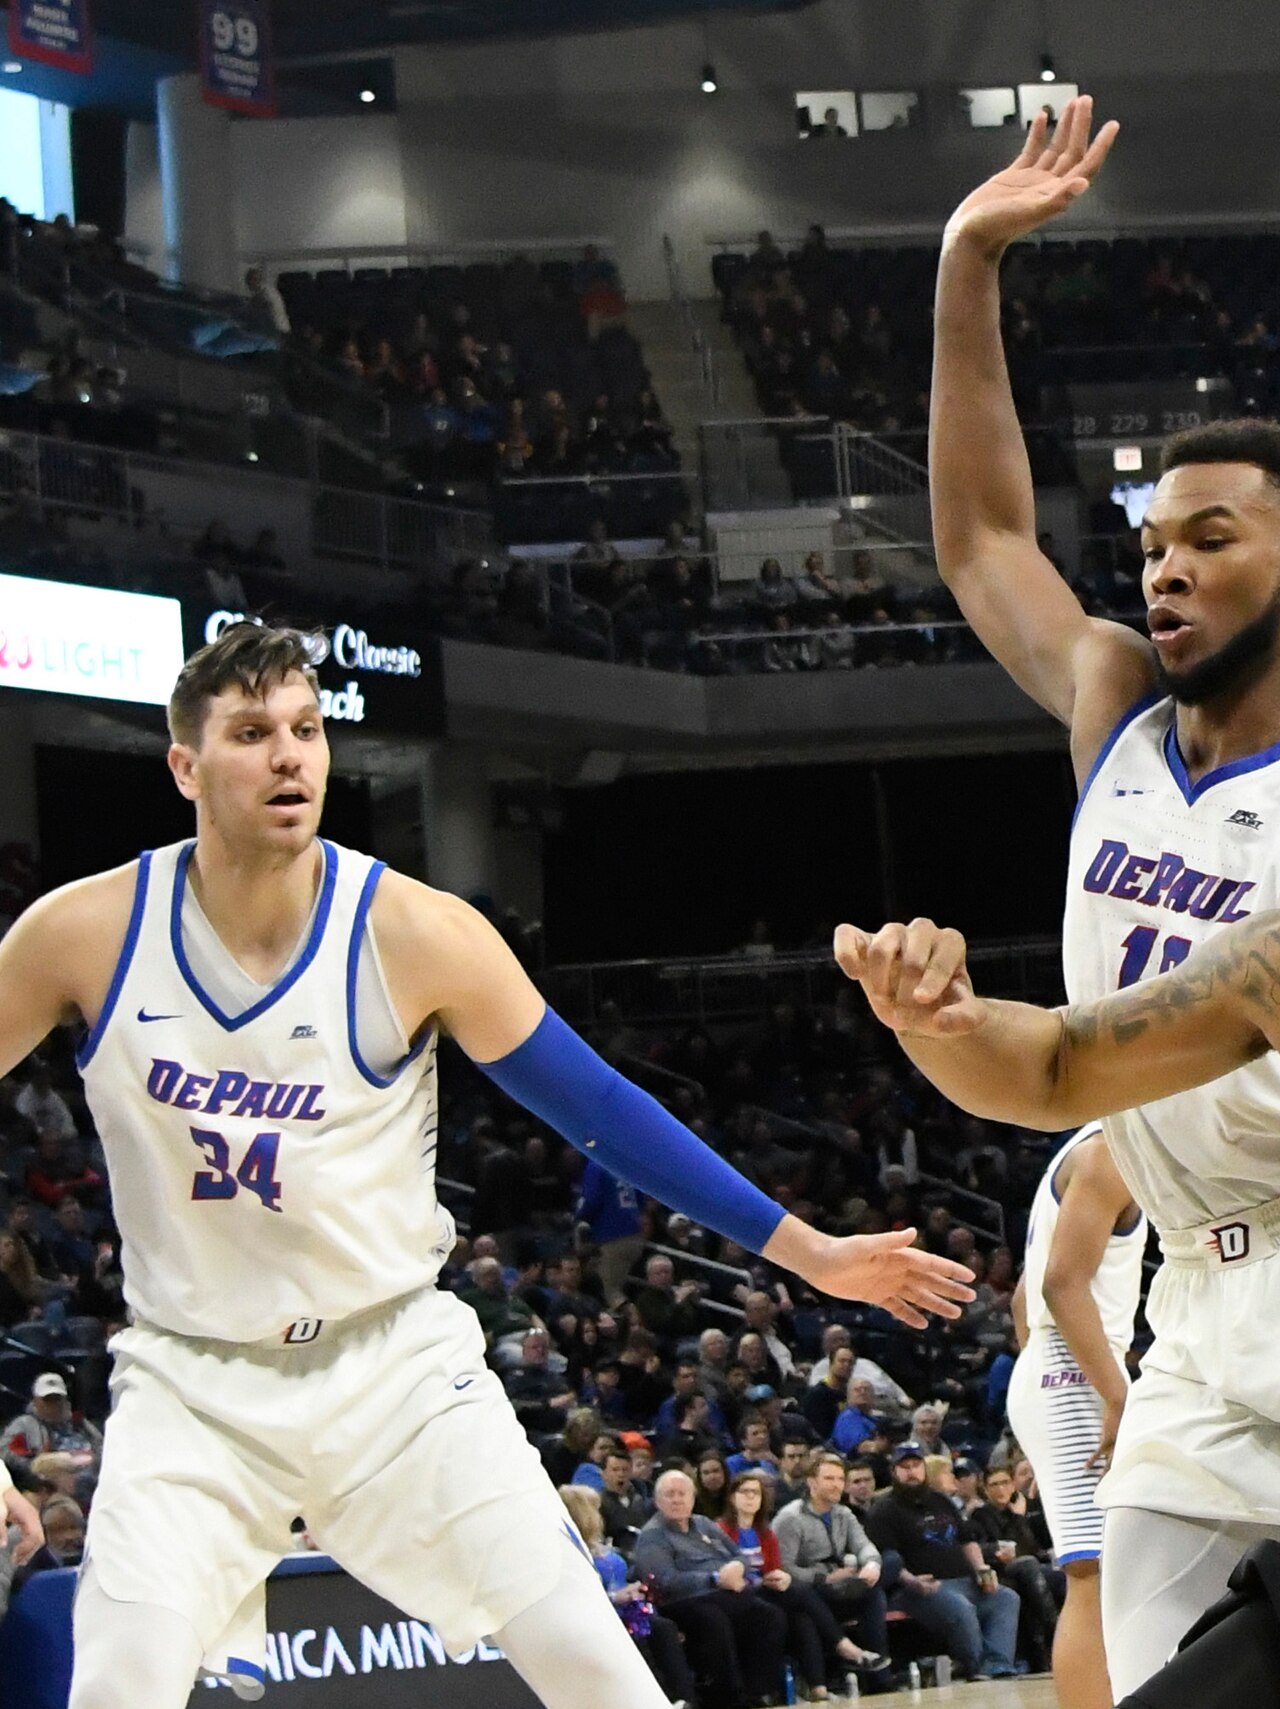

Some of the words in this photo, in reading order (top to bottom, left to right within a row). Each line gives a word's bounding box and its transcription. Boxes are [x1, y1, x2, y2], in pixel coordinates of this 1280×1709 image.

[212, 12, 259, 57] 99
[42, 640, 143, 683] LIGHT
[333, 624, 422, 677] Classic
[189, 1126, 284, 1214] 34
[1040, 1371, 1089, 1388] DEPAU
